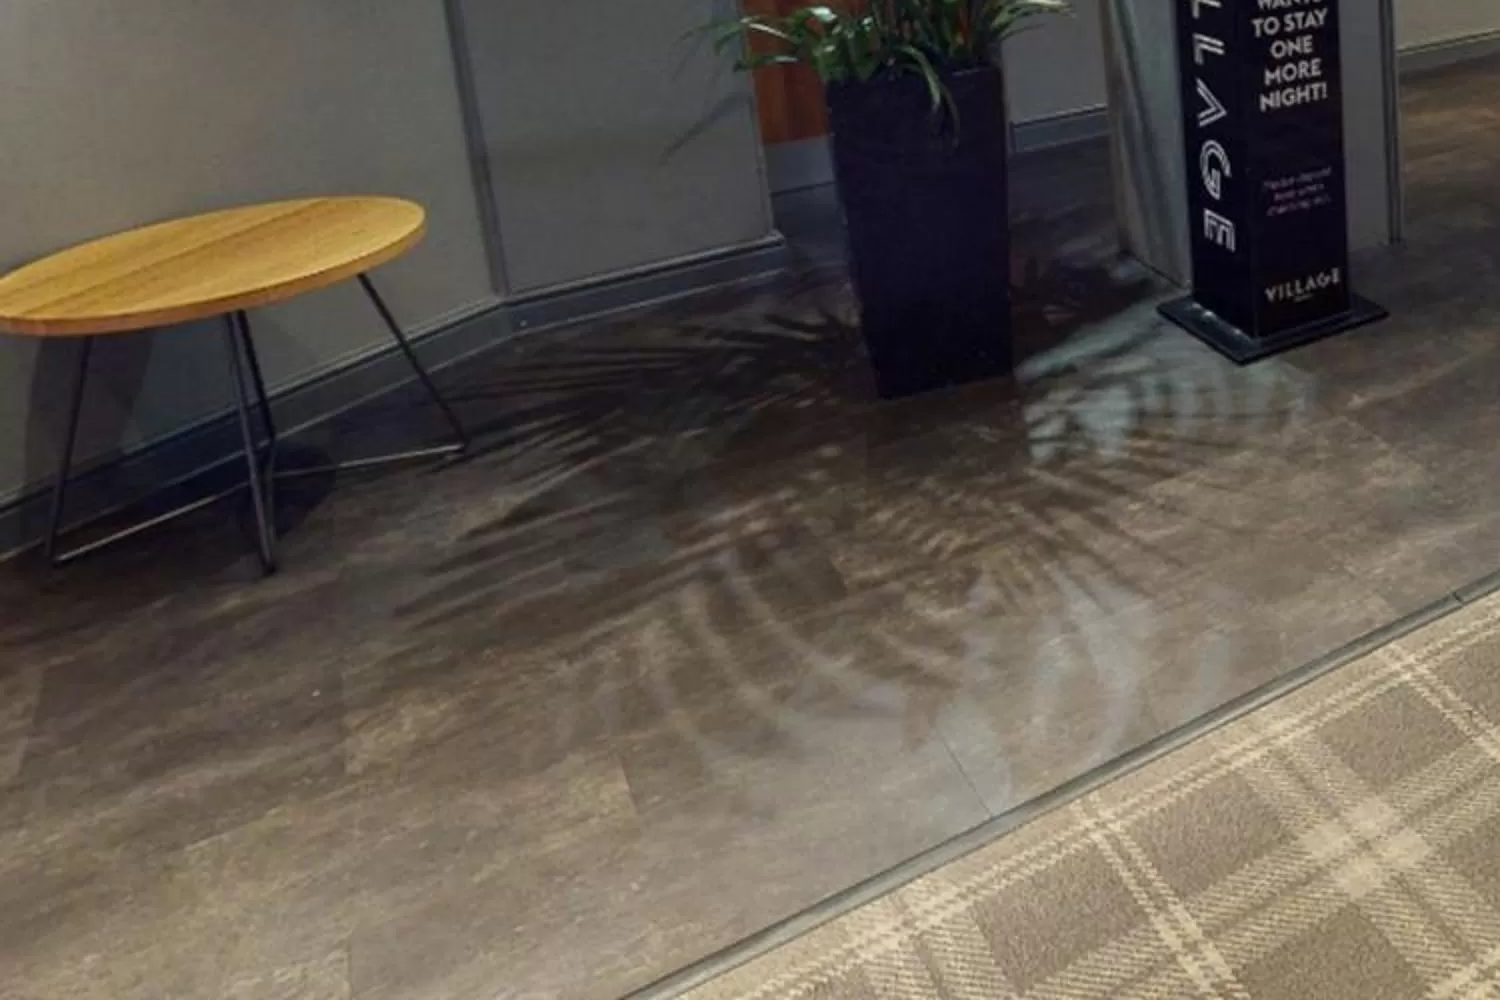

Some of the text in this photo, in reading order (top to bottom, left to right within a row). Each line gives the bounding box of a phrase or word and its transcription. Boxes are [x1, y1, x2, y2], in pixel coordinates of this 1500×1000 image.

[1252, 7, 1328, 38] TO STAY
[1270, 35, 1314, 59] ONE
[1264, 58, 1322, 86] MORE
[1259, 82, 1328, 113] NIGHT!
[1264, 267, 1341, 303] VILLAGE
